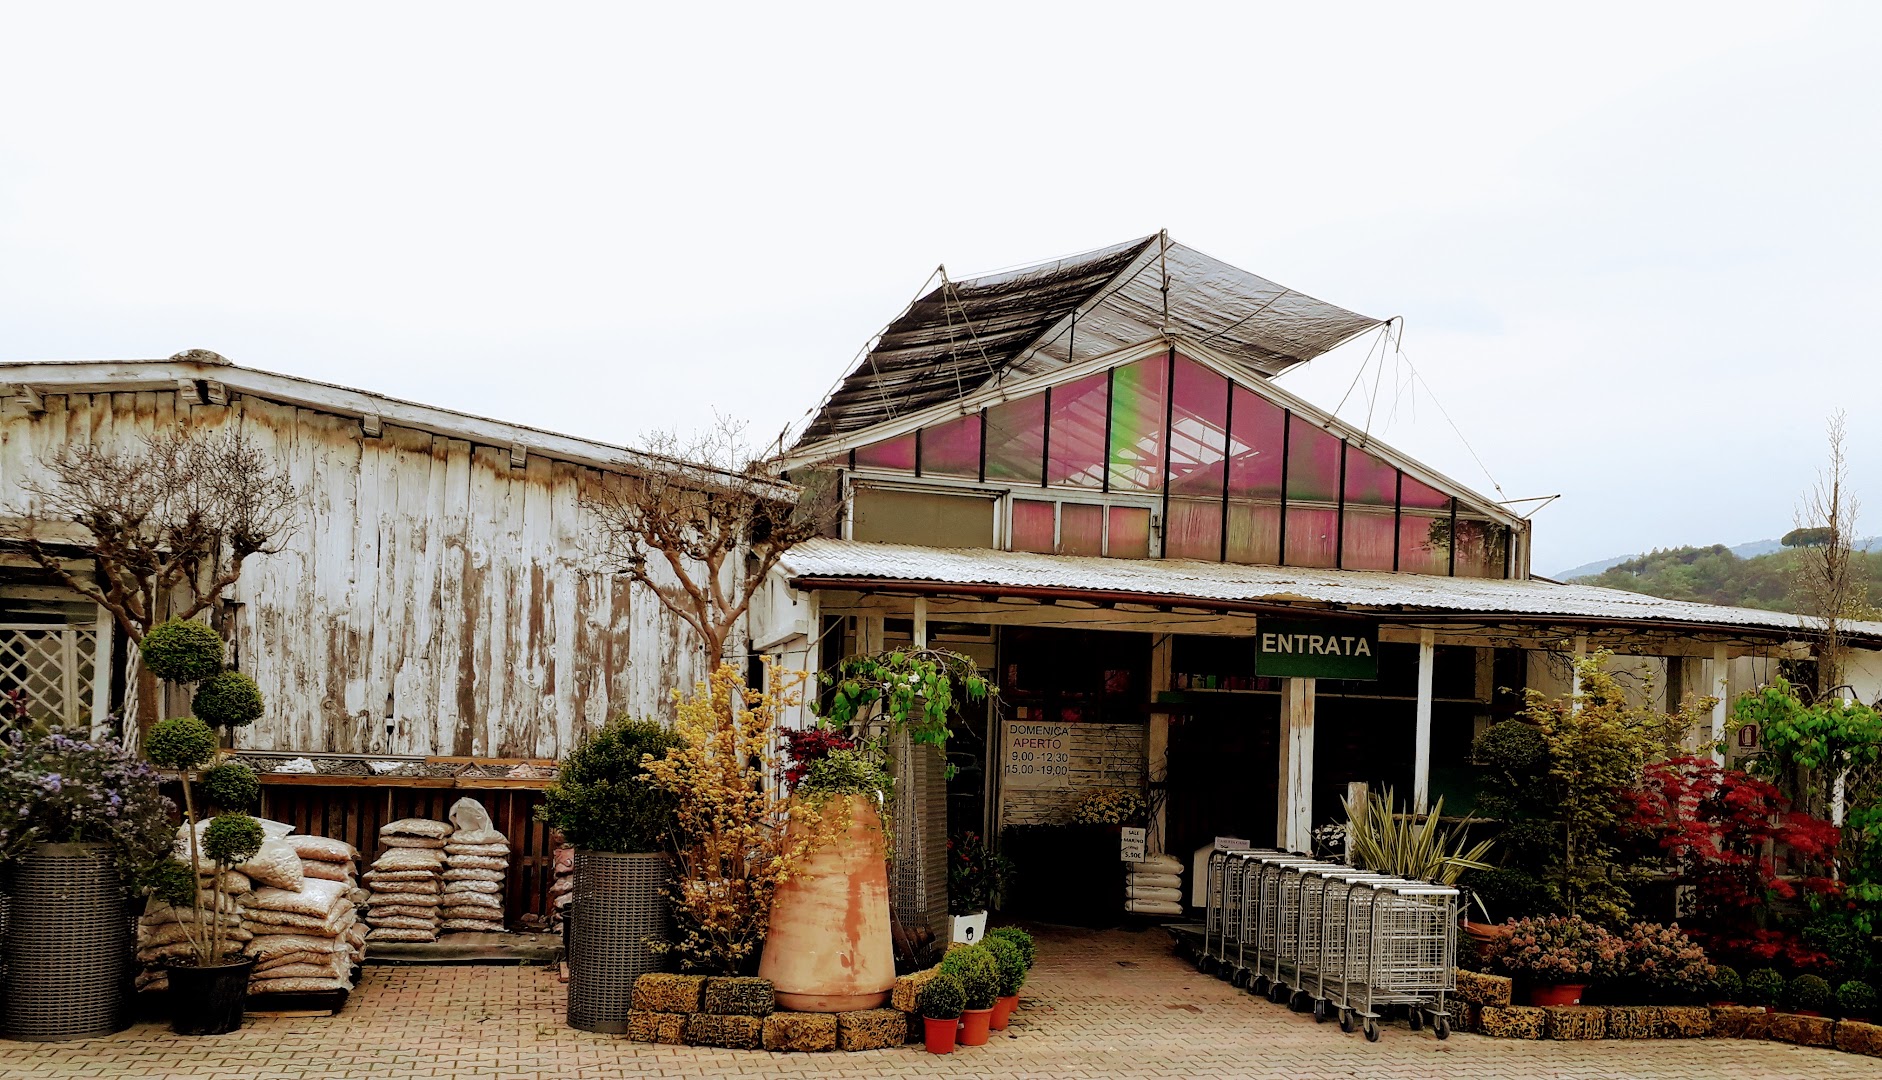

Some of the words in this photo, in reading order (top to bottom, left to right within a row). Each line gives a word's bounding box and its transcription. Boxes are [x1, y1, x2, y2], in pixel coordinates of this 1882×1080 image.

[1262, 633, 1371, 657] ENTRATA
[1010, 724, 1069, 736] DOMENICA
[1013, 738, 1062, 749] APERTO
